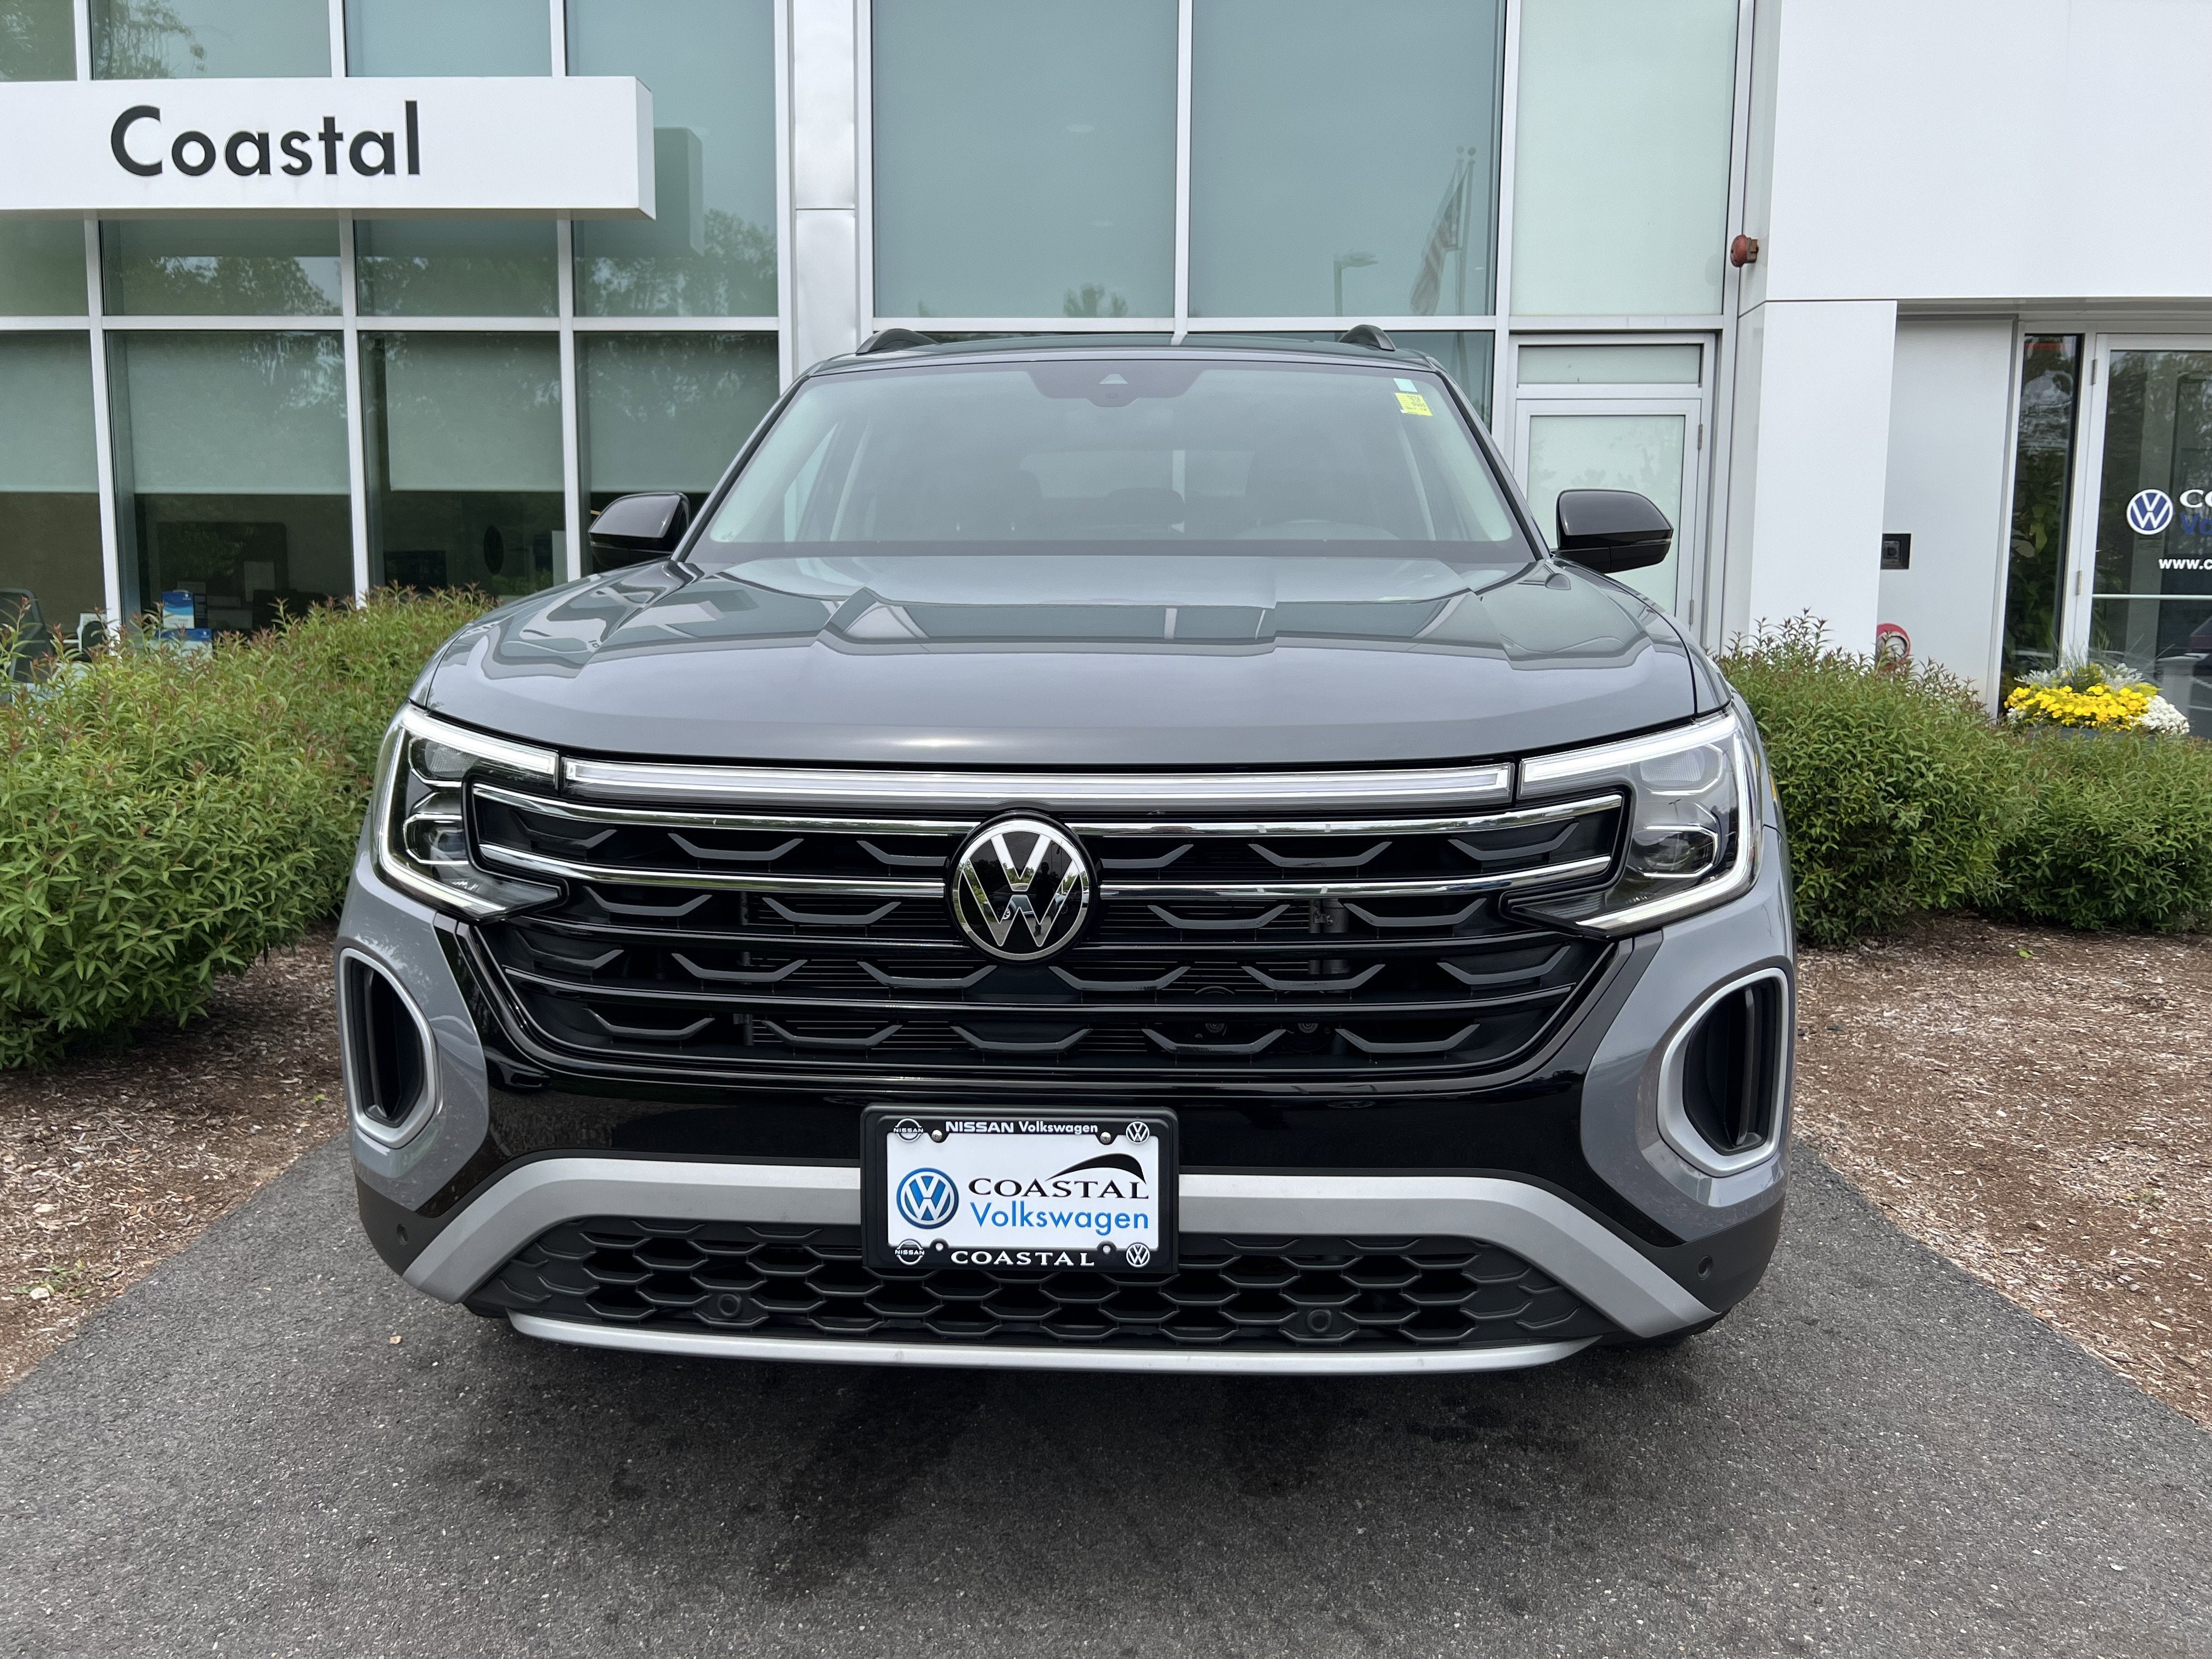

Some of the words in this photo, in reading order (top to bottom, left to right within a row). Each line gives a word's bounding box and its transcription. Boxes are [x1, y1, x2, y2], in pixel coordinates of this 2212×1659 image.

[110, 100, 420, 176] Coastal
[2180, 489, 2212, 508] C
[2158, 558, 2212, 570] www.c
[958, 827, 1084, 952] VW
[945, 1121, 1014, 1133] NISSAN
[1018, 1120, 1098, 1135] Volkswagen
[900, 1171, 955, 1224] VW
[968, 1177, 1149, 1199] COASTAL
[970, 1200, 1149, 1236] Volkswagen
[951, 1250, 1095, 1267] COASTAL
